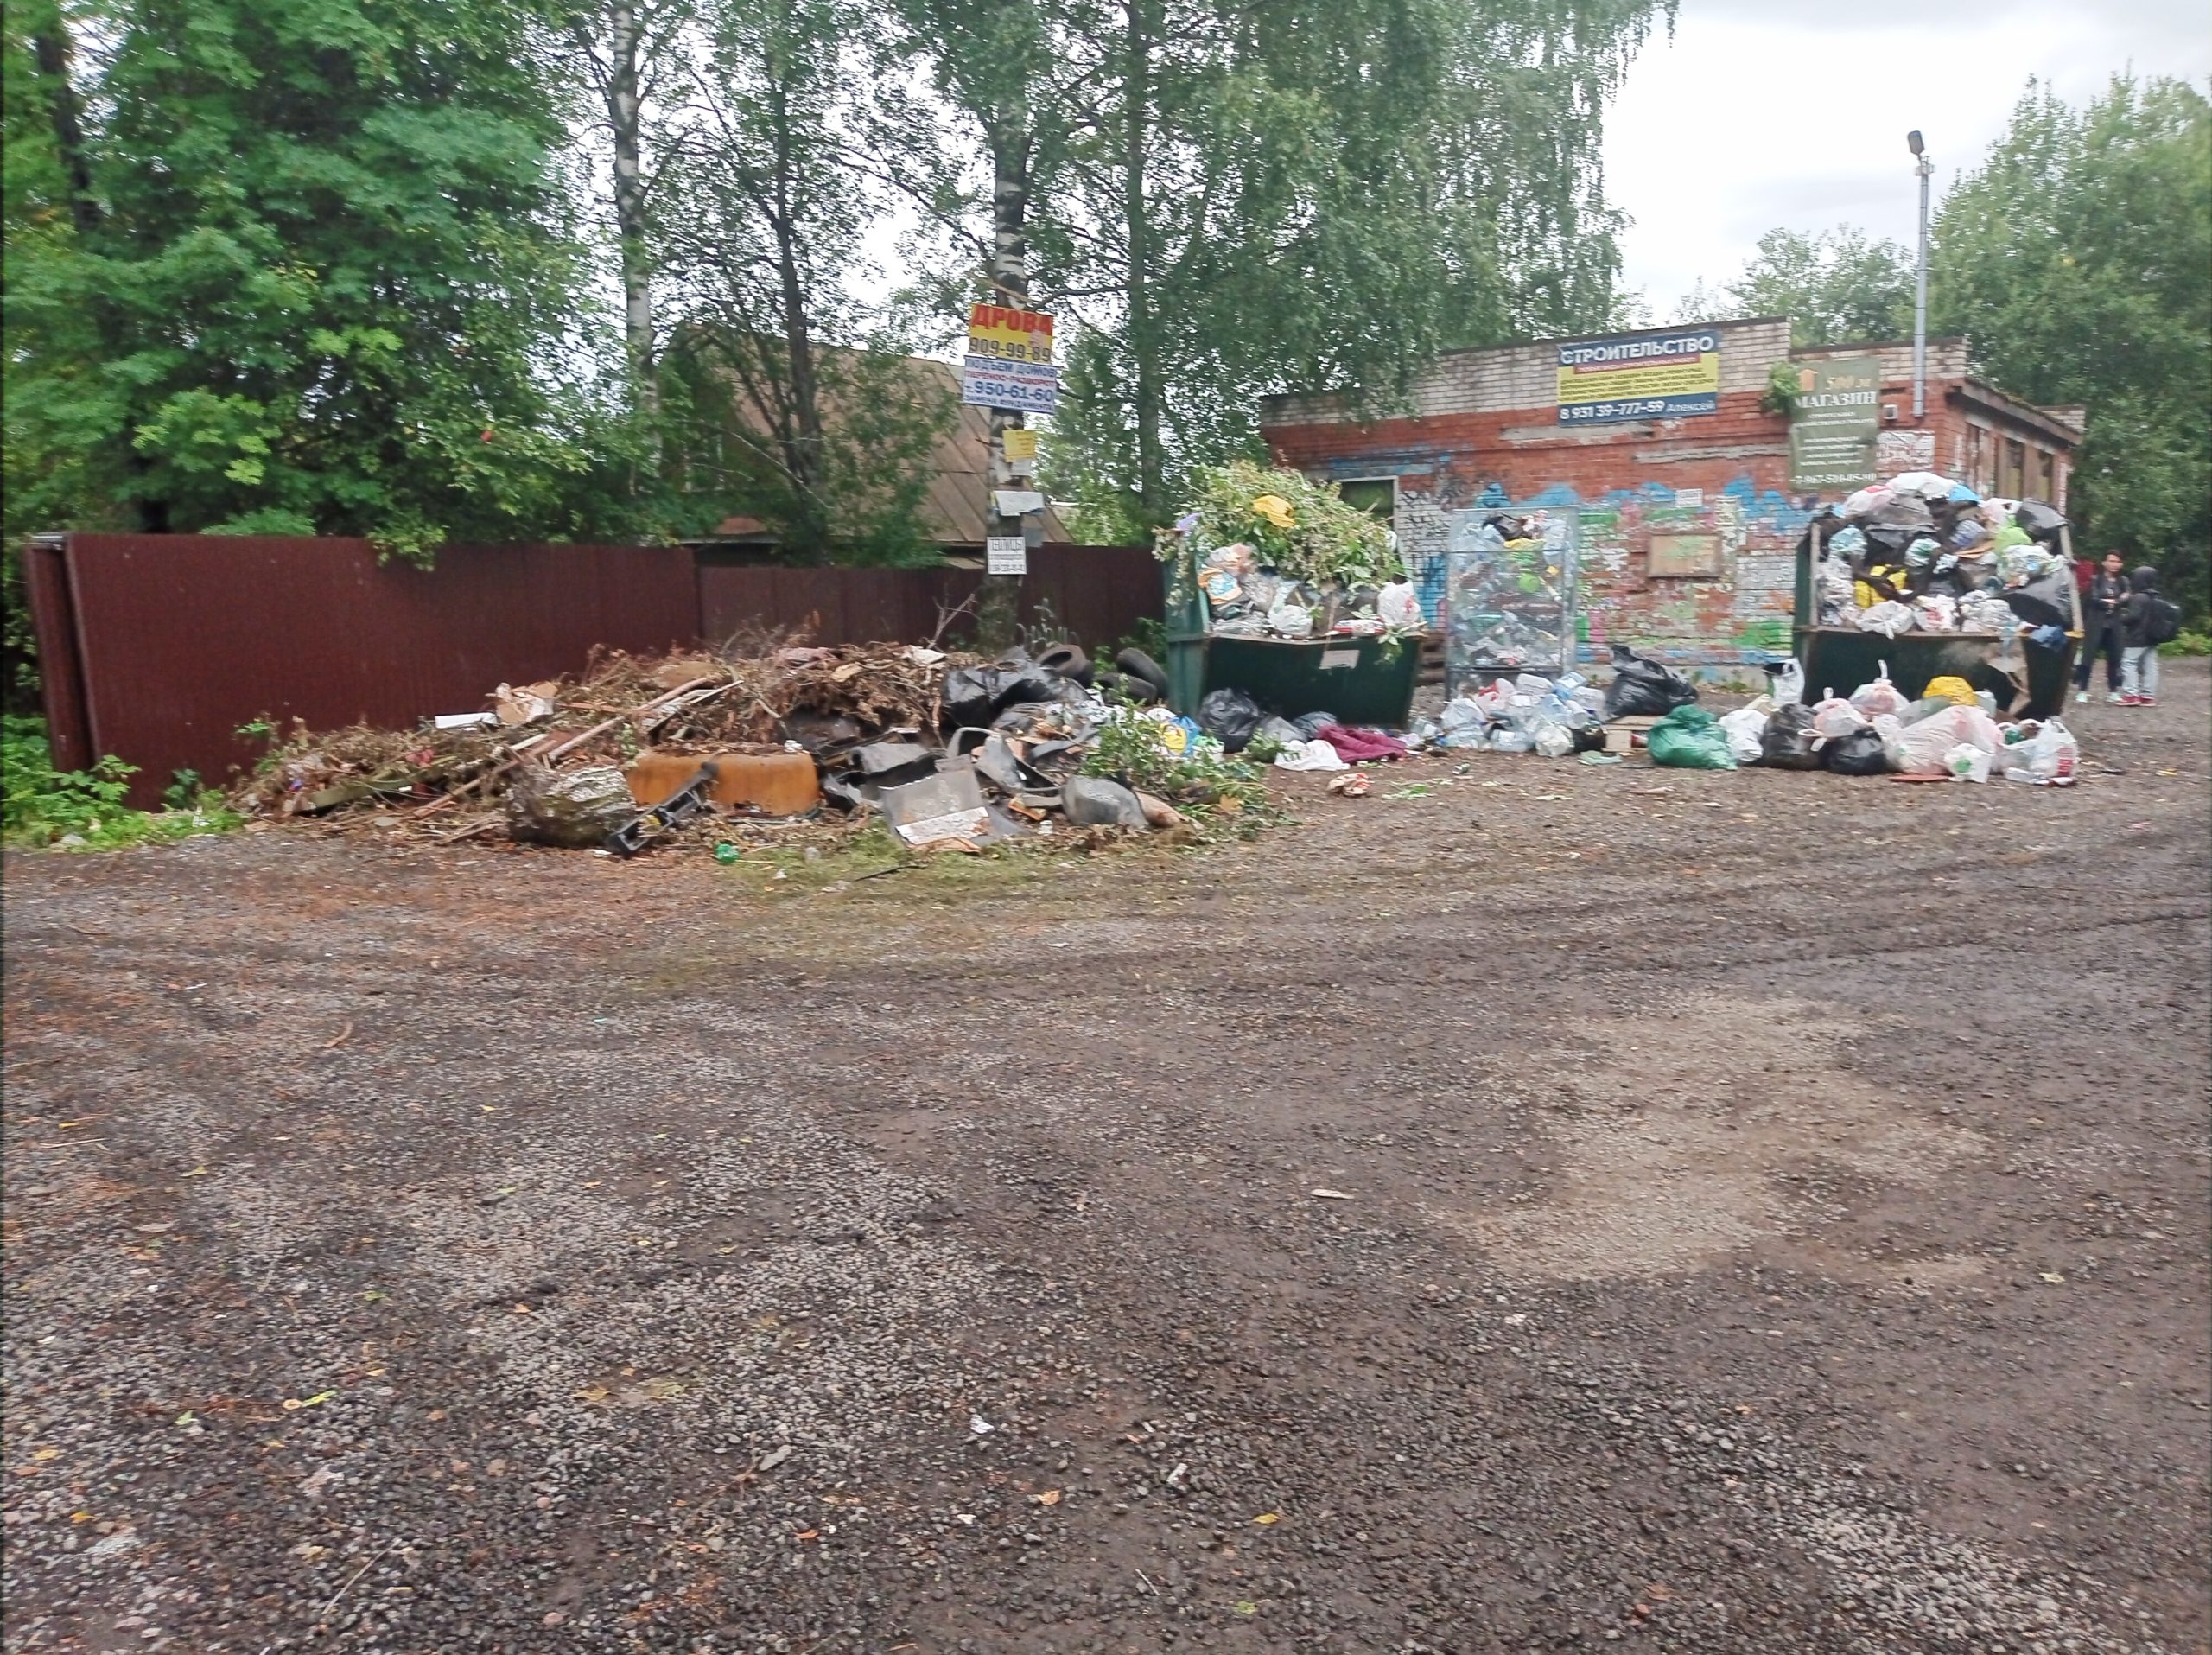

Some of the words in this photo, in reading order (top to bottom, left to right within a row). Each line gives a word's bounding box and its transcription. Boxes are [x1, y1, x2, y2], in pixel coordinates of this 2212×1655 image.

[972, 304, 1052, 336] ДРОВА
[969, 337, 1050, 361] 909-99-89
[1560, 336, 1714, 365] СТРОИТЕЛЬСТВО
[975, 381, 1052, 402] 950-61-60
[1794, 391, 1877, 409] МАГАЗИН
[1560, 408, 1569, 419] 8
[1596, 400, 1665, 417] 39-777-59
[1666, 400, 1715, 412] Алексей
